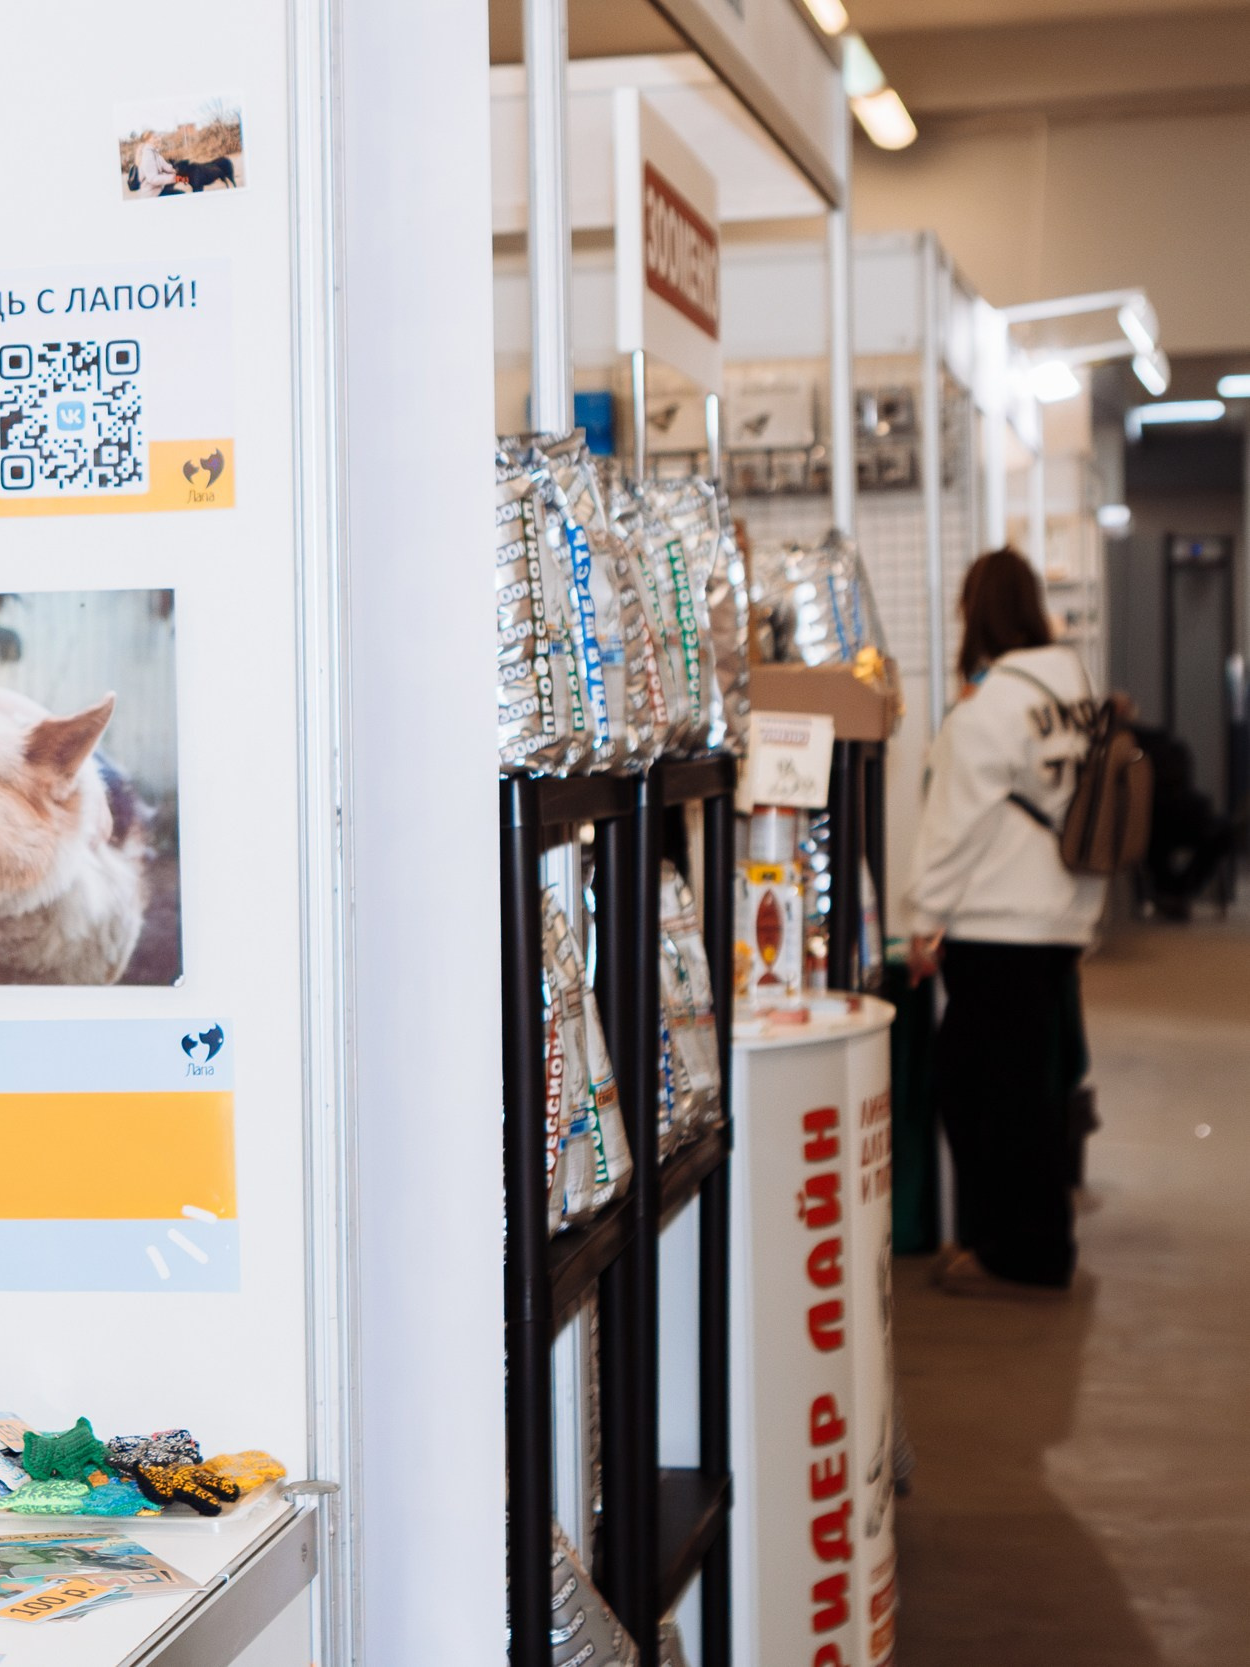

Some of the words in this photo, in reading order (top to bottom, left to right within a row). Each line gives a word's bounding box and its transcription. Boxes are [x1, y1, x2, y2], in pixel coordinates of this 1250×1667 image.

[37, 289, 55, 314] С
[65, 275, 197, 313] ЛАПОЙ!
[185, 1062, 215, 1077] Лапа
[796, 1105, 845, 1353] ЛАЙН
[10, 1596, 67, 1616] 100
[61, 1588, 97, 1599] р.
